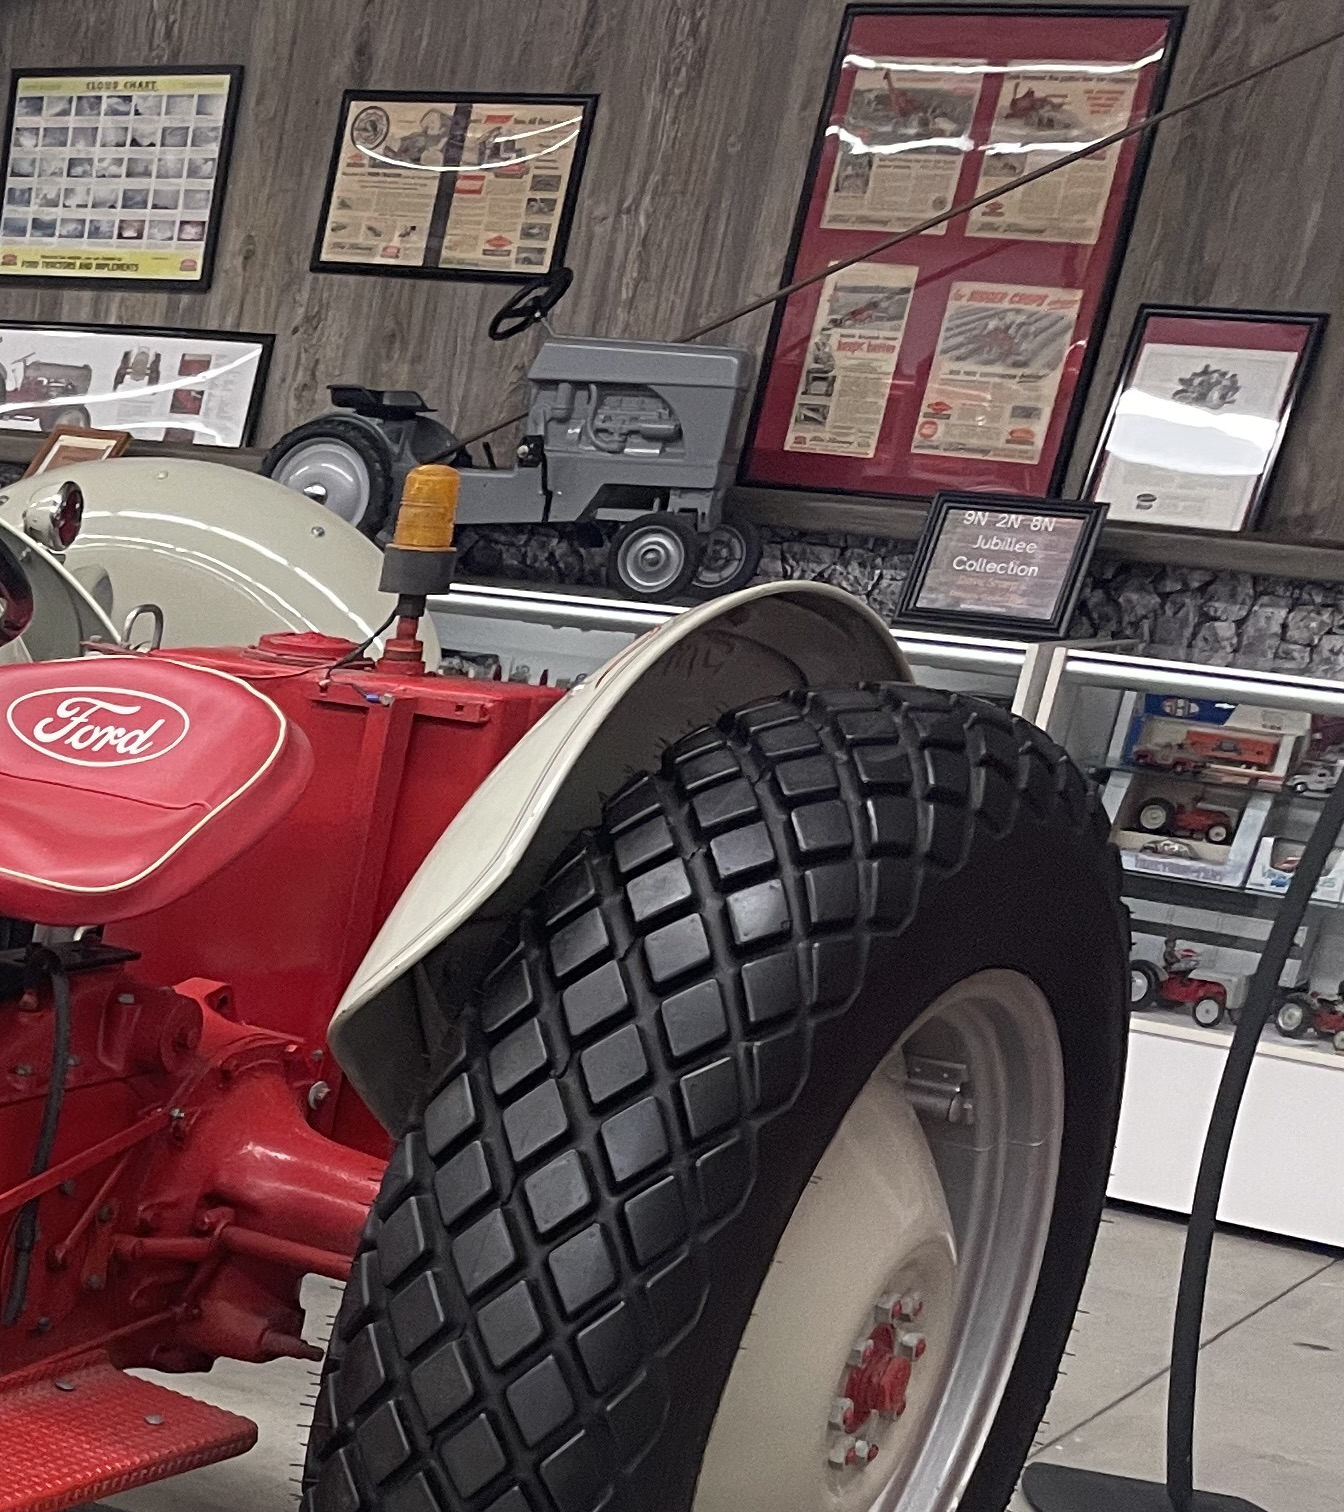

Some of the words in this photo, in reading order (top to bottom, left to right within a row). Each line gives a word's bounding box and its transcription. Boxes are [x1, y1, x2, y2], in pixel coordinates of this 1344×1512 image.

[963, 510, 989, 527] 9N
[995, 513, 1023, 530] 2N
[1029, 516, 1056, 532] 8N
[952, 555, 1039, 577] Collection
[33, 697, 166, 755] Ford
